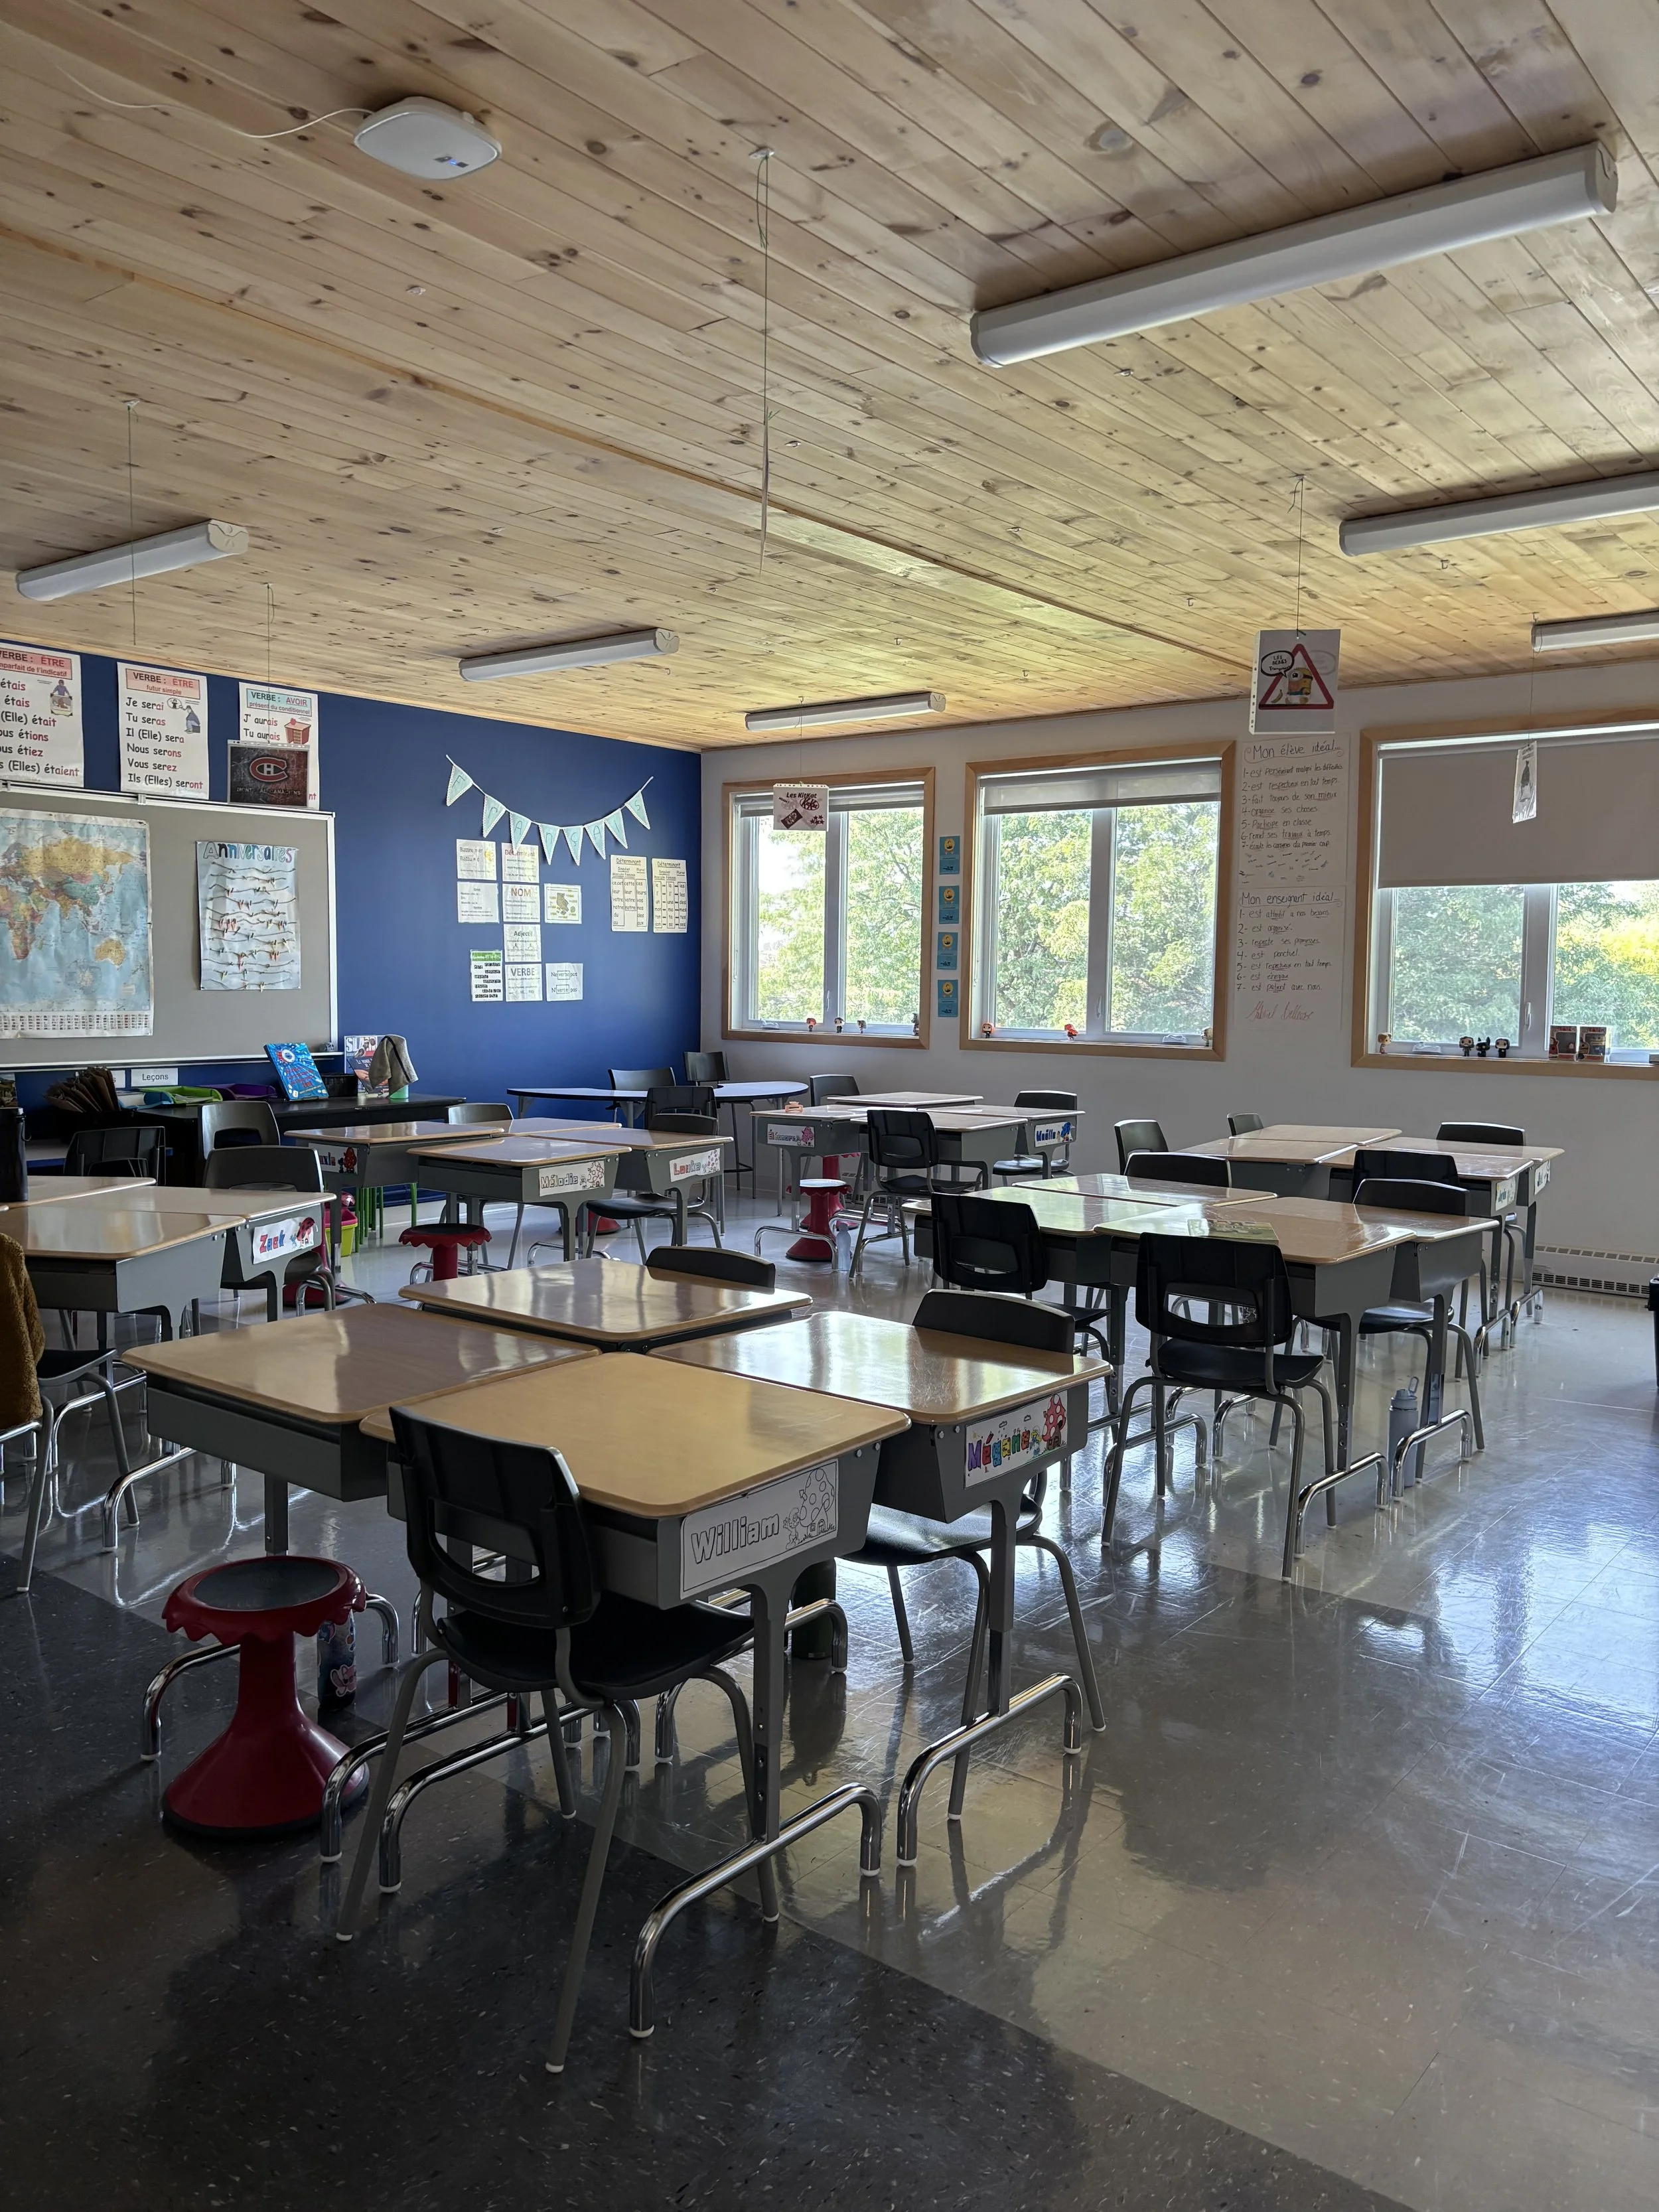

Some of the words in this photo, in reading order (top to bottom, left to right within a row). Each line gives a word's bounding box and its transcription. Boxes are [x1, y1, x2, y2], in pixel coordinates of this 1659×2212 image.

[1, 678, 26, 691] étais
[133, 672, 161, 684] VERBE
[162, 687, 182, 696] simple
[5, 695, 30, 707] étais
[126, 697, 137, 707] Je
[141, 701, 164, 711] serai
[251, 692, 276, 701] VERBE
[286, 697, 307, 706] AVOIR
[1, 711, 27, 725] (Elle)
[32, 715, 56, 727] était
[125, 712, 137, 723] Tu
[142, 717, 166, 726] seras
[255, 717, 278, 726] aurais
[19, 729, 48, 742] étions
[126, 727, 134, 737] Il
[138, 729, 162, 742] (Elle)
[165, 734, 184, 743] sera
[244, 728, 254, 737] Tu
[257, 731, 280, 741] aurais
[17, 745, 43, 757] étiez
[127, 743, 149, 754] Nous
[153, 748, 182, 758] serons
[1253, 745, 1275, 760] Mon
[1280, 743, 1305, 755] élève
[8, 760, 40, 774] (Elles)
[44, 763, 80, 776] étaient
[127, 758, 149, 769] Vous
[153, 763, 177, 772] serez
[127, 773, 141, 783] Ils
[145, 774, 173, 788] (Elles)
[176, 780, 203, 789] seront
[203, 842, 293, 863] Anniversaires
[511, 888, 531, 897] NOM
[1242, 892, 1261, 905] Mon
[1249, 909, 1262, 919] est
[142, 1073, 169, 1082] Leçons
[674, 1160, 701, 1175] Louka
[541, 1173, 578, 1189] Mélodie
[259, 1230, 285, 1254] Zack
[968, 1430, 1031, 1471] Mégane
[691, 1514, 780, 1564] William
